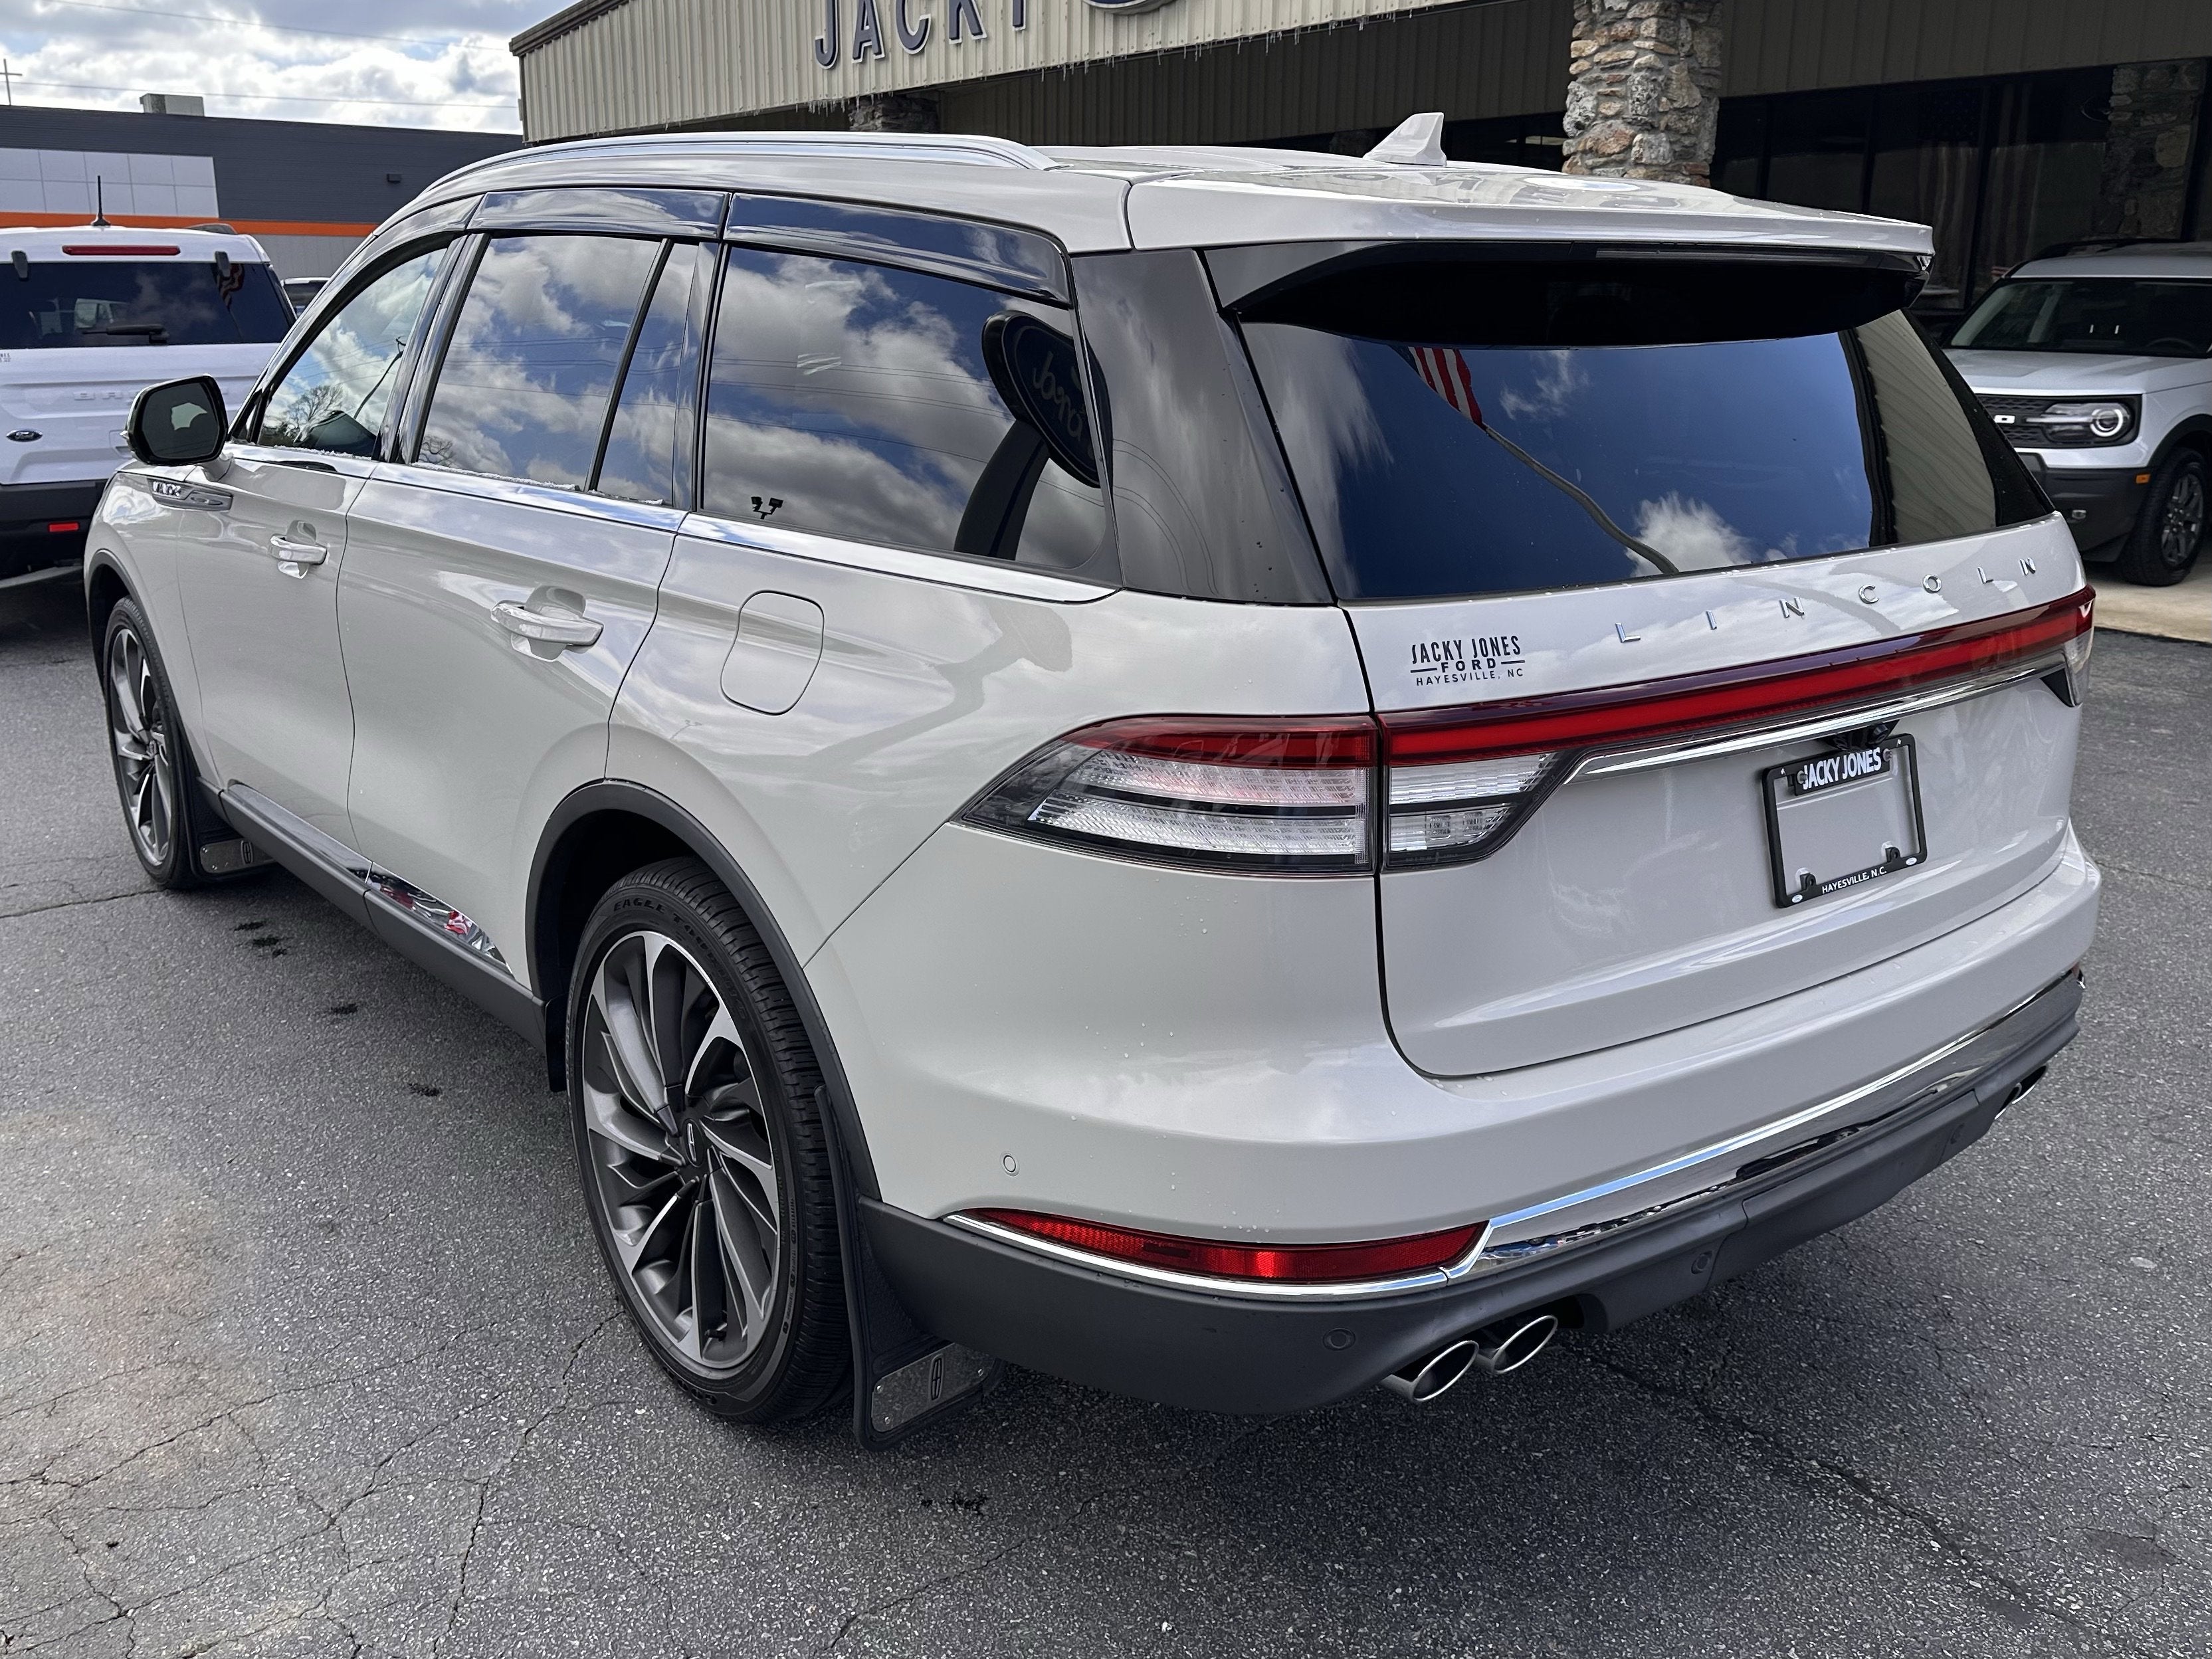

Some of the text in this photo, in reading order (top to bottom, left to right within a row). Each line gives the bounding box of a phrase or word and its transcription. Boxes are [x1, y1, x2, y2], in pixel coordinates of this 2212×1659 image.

[1615, 557, 2037, 644] LINCOLN
[1411, 635, 1521, 664] JACKY JONES
[1416, 667, 1524, 686] HAYESVILLE, NC
[1441, 657, 1496, 673] FORD
[1803, 747, 1882, 790] JACKY JONES
[1821, 866, 1887, 894] HAYESVILLE, N.C.
[613, 897, 667, 915] EAGLE
